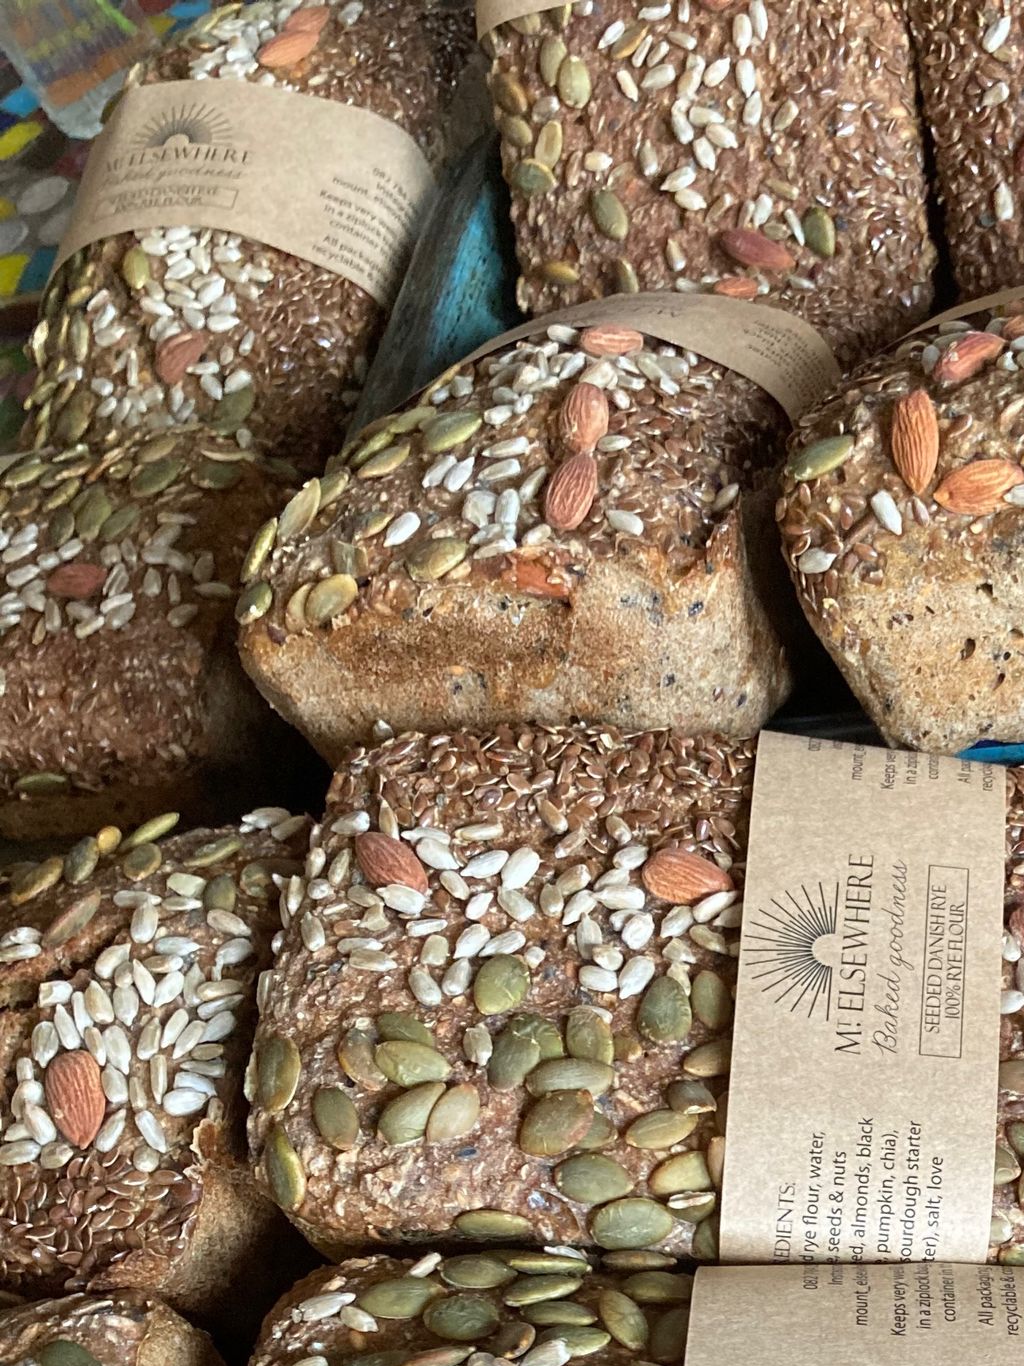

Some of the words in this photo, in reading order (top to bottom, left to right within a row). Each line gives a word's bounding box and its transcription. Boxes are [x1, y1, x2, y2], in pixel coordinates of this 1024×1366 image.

[880, 765, 896, 790] Keeps
[958, 774, 970, 783] All
[881, 859, 914, 971] goodness
[930, 884, 947, 910] RYE
[837, 853, 874, 1012] ELSEWHERE
[927, 915, 945, 970] DANISH
[948, 901, 965, 951] FLOUR
[947, 955, 963, 981] RYE
[872, 971, 901, 1055] Baked
[925, 974, 942, 1033] SEEDED
[945, 985, 961, 1019] 100%
[809, 1131, 825, 1178] water,
[856, 1117, 873, 1157] black
[881, 1130, 899, 1170] chia),
[907, 1121, 921, 1170] starter
[833, 1151, 846, 1186] nuts
[927, 1156, 943, 1190] love
[802, 1184, 821, 1224] flour,
[829, 1191, 844, 1203] &
[851, 1163, 872, 1238] almonds,
[877, 1175, 895, 1253] pumpkin,
[926, 1195, 942, 1227] salt,
[773, 1182, 796, 1261] EDIENTS:
[803, 1231, 819, 1252] rye
[827, 1208, 843, 1252] seeds
[893, 1281, 908, 1301] very
[915, 1275, 934, 1307] ziplock
[941, 1276, 956, 1322] container
[1001, 1284, 1022, 1336] recyclable
[890, 1304, 909, 1336] Keeps
[917, 1319, 931, 1329] in
[978, 1312, 994, 1326] All
